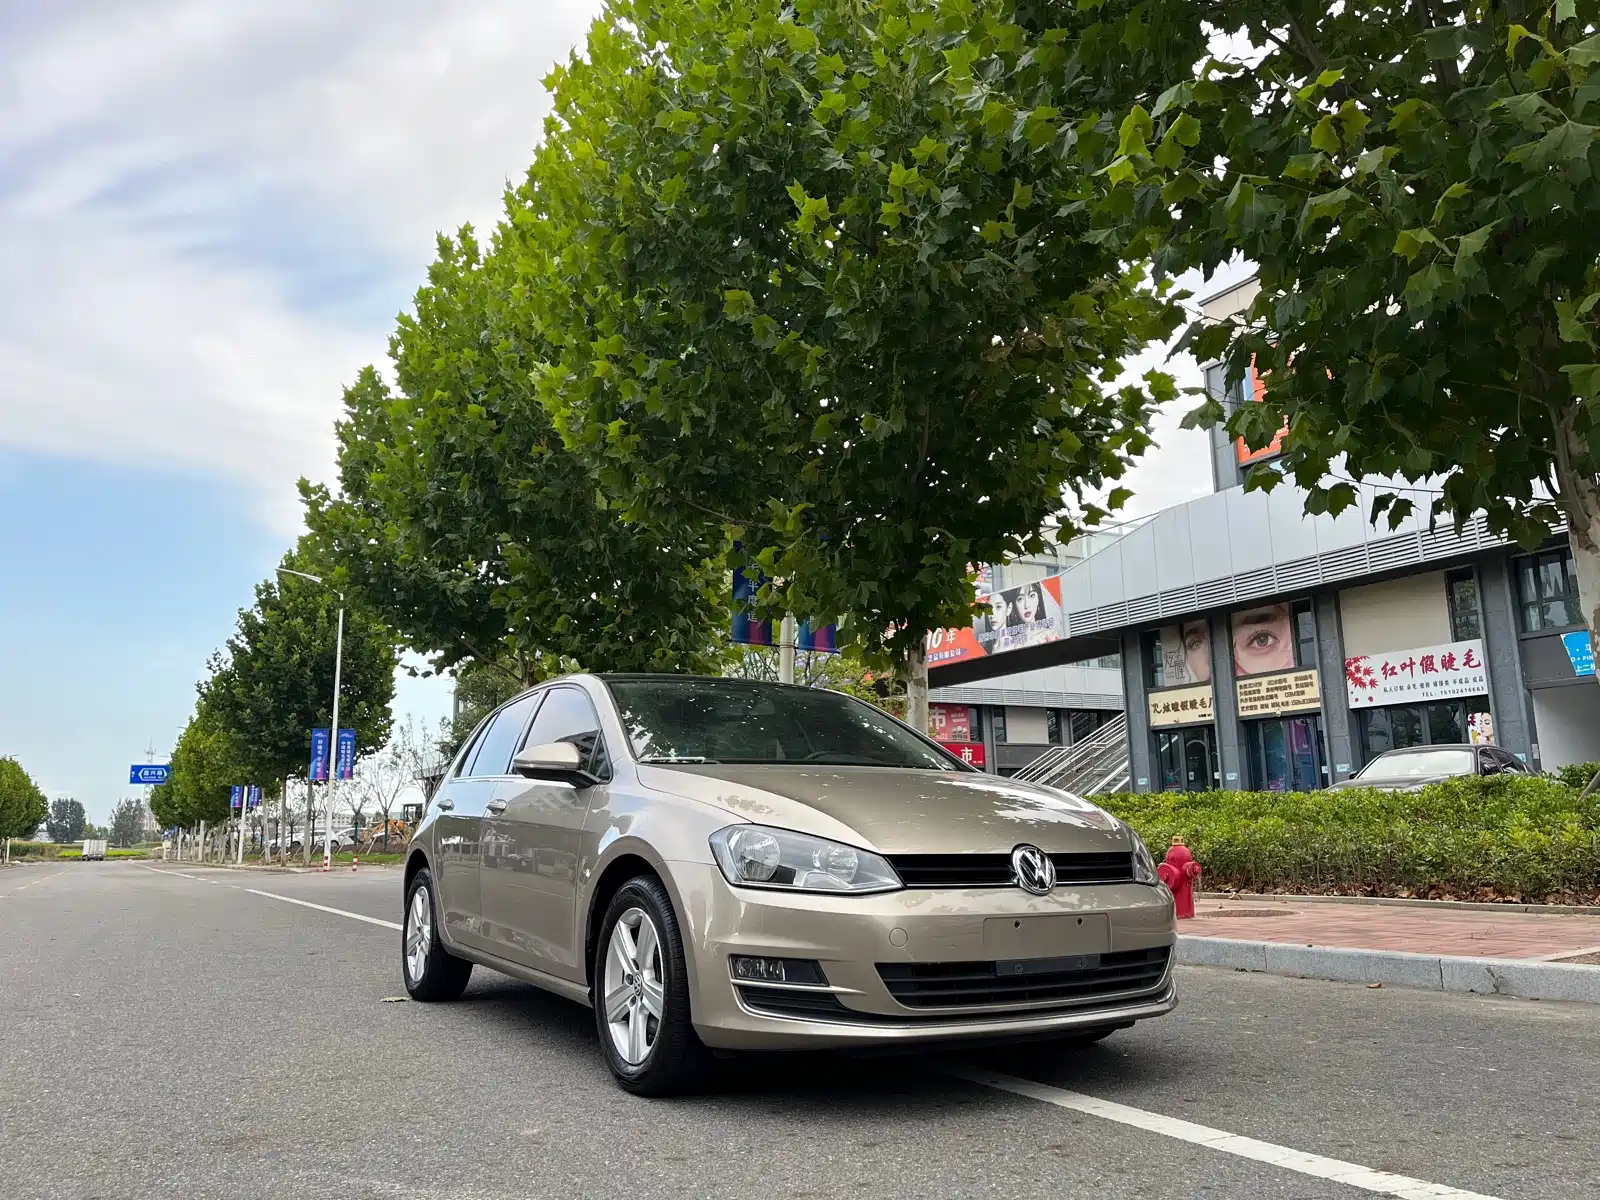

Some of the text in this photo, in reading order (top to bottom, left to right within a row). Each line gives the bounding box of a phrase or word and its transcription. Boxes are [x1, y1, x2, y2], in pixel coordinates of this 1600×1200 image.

[1381, 648, 1481, 680] 红叶假睫毛
[960, 746, 973, 763] 市
